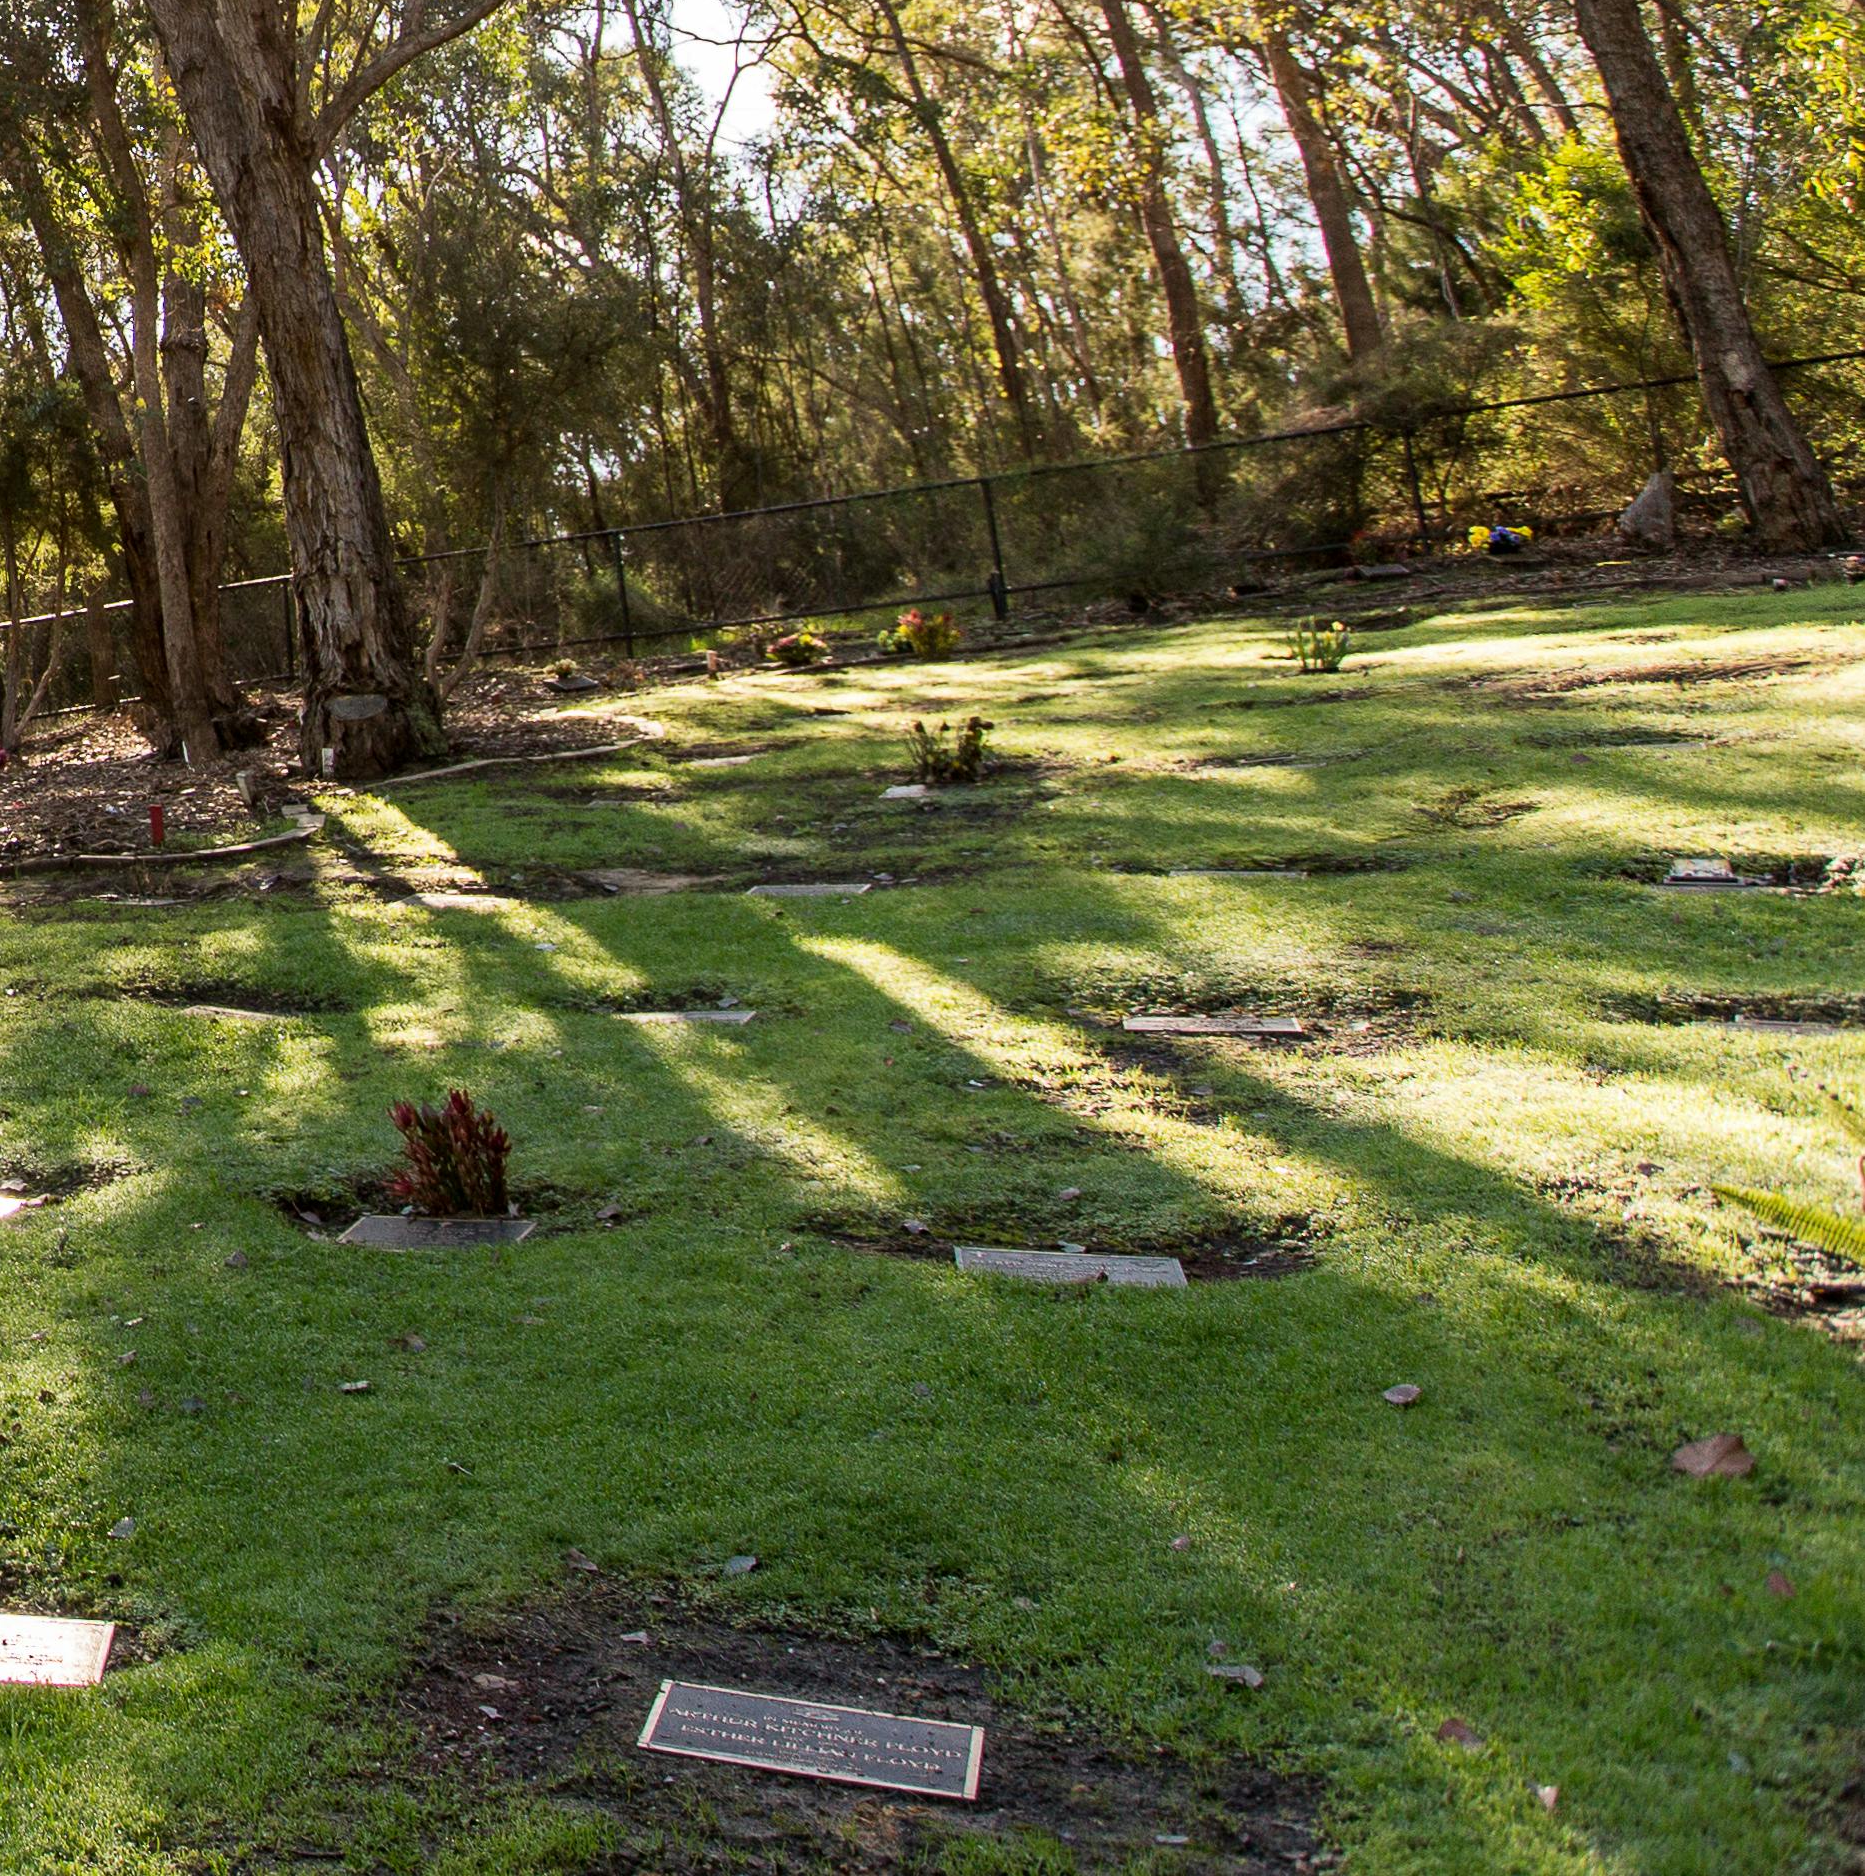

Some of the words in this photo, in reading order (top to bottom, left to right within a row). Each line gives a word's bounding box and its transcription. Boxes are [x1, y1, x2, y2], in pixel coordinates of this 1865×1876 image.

[669, 1707, 758, 1729] ARTHUR
[886, 1741, 961, 1759] FLOYD
[681, 1724, 766, 1745] ESTHER
[863, 1753, 941, 1770] FLOYD
